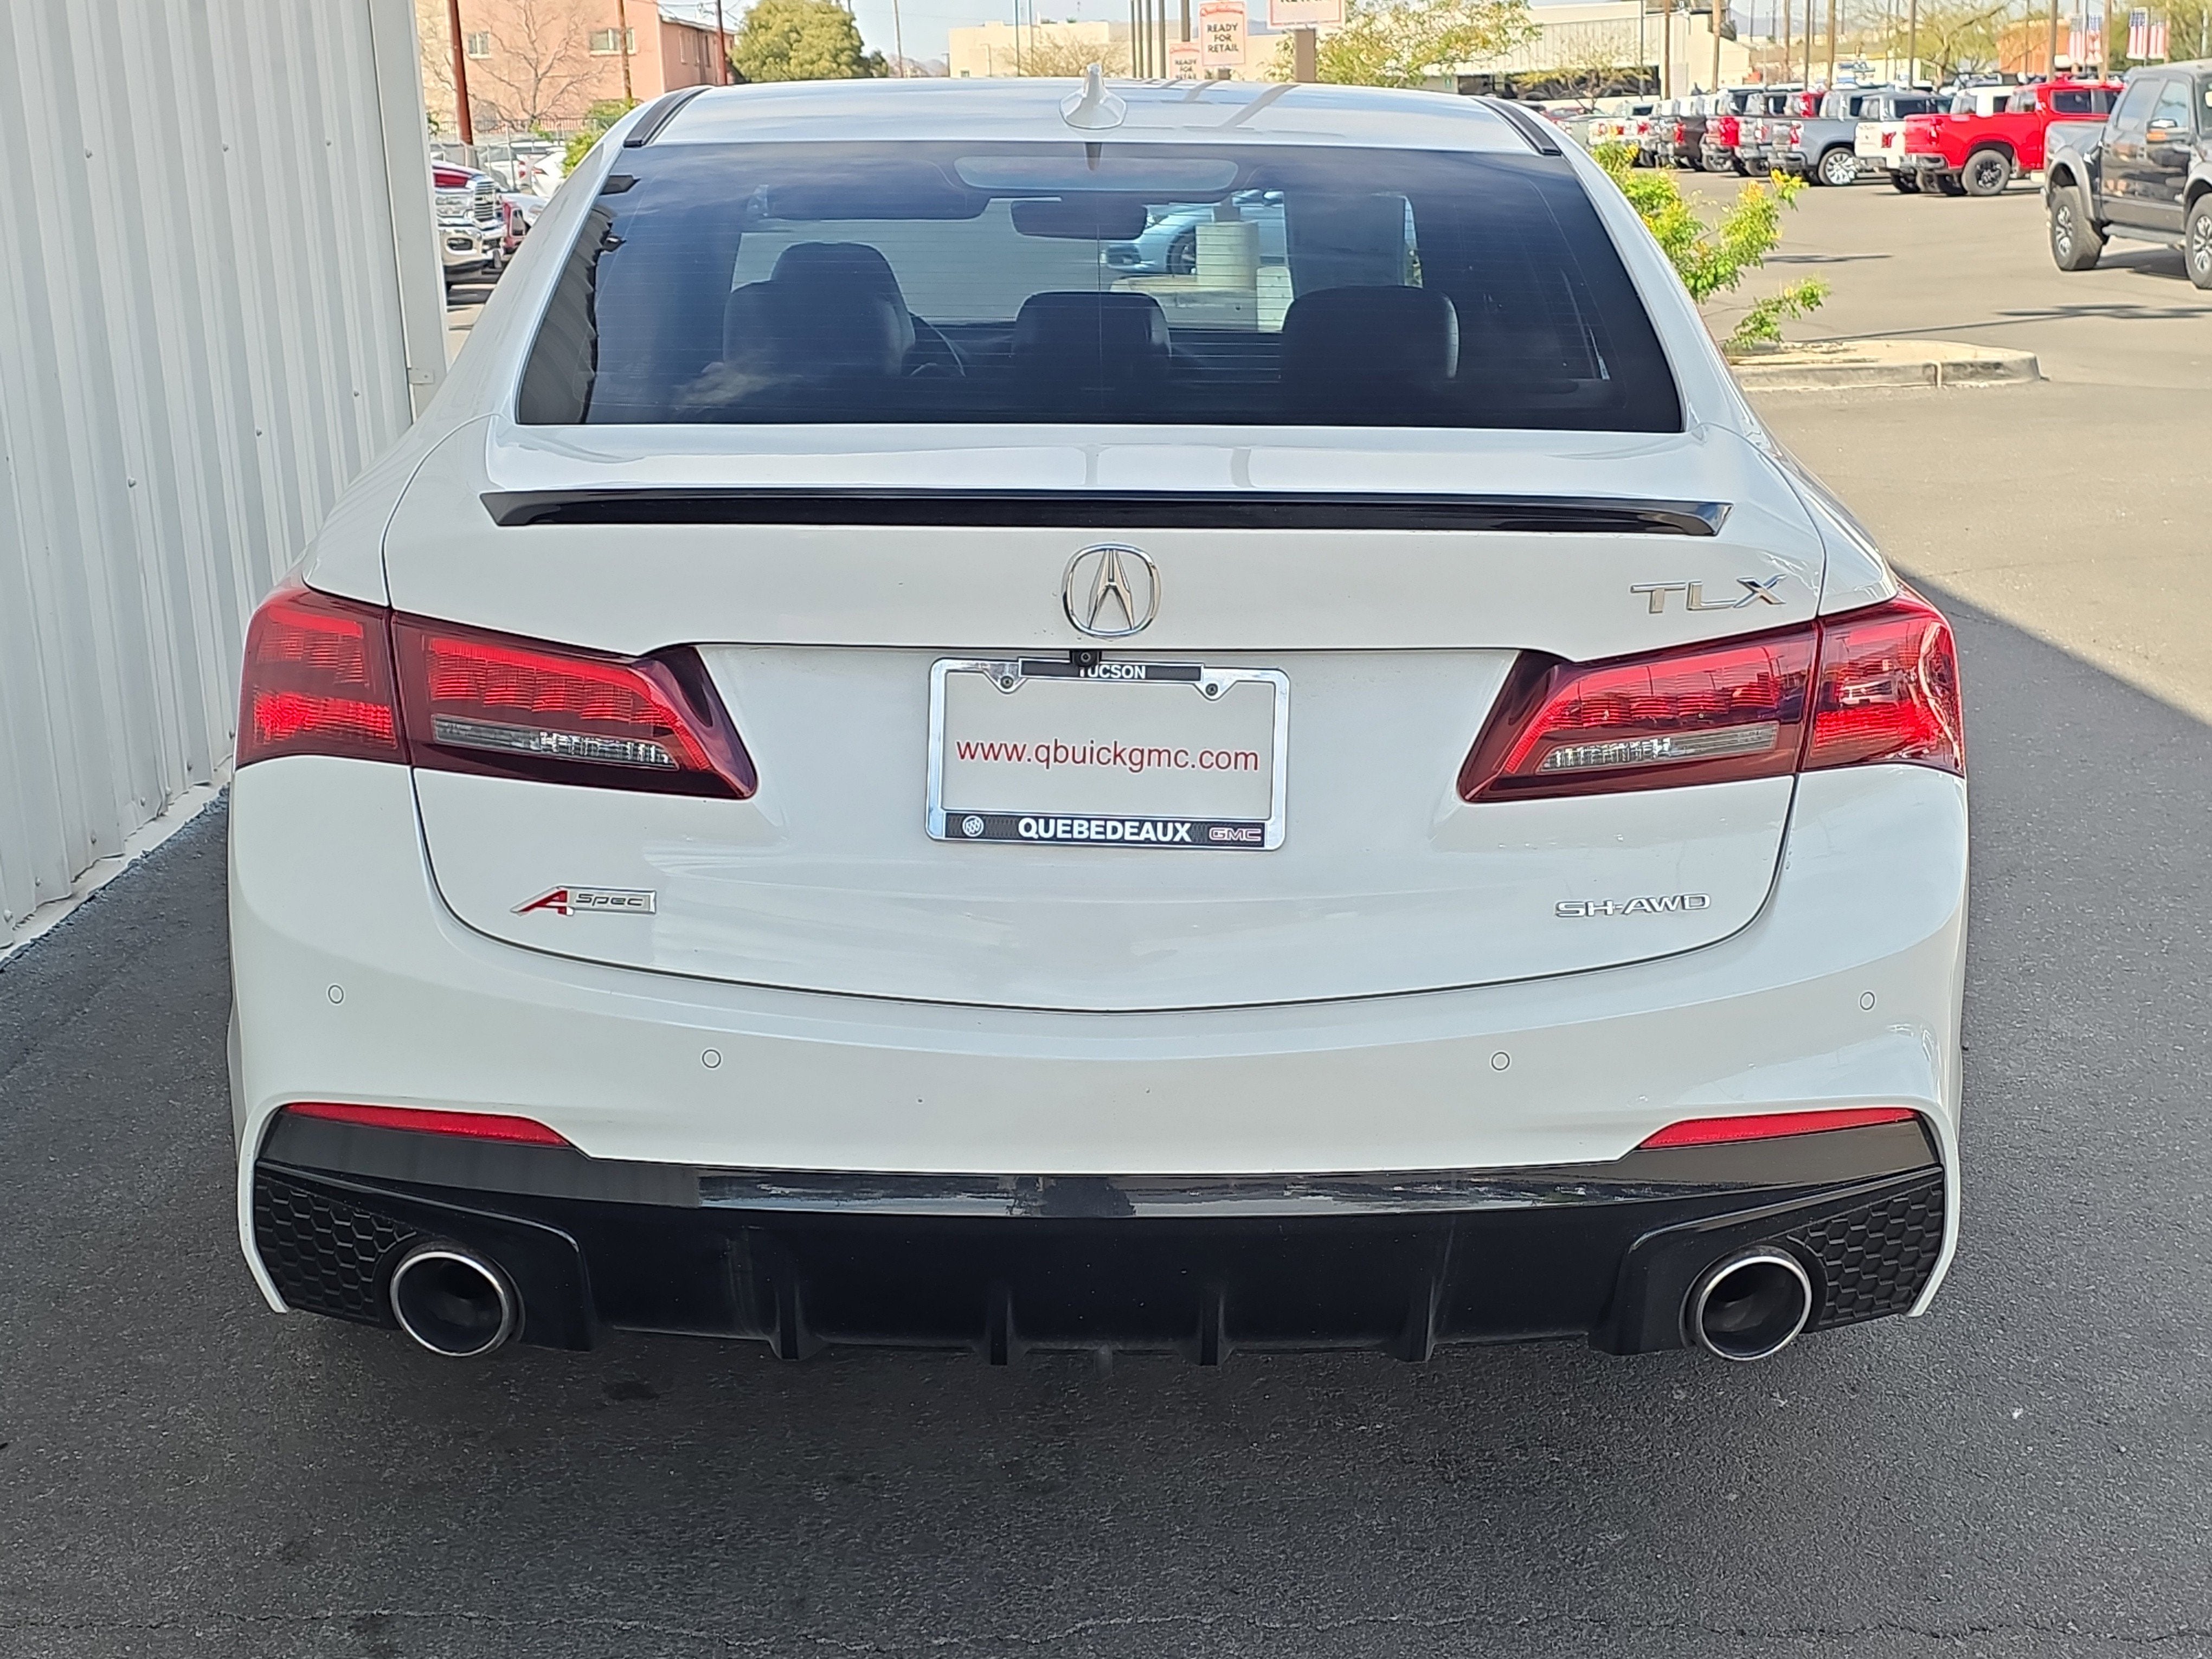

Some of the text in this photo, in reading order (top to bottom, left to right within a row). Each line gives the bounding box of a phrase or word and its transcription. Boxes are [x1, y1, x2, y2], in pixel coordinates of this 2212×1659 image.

[1207, 23, 1238, 33] READY
[1207, 44, 1239, 53] RETAIL
[1630, 574, 1787, 613] TLX
[956, 738, 1258, 773] www.qbuickgmc.com
[1018, 818, 1192, 842] QUEBEDEAUX
[1208, 827, 1262, 841] GMC
[1555, 893, 1711, 917] SH-AWD
